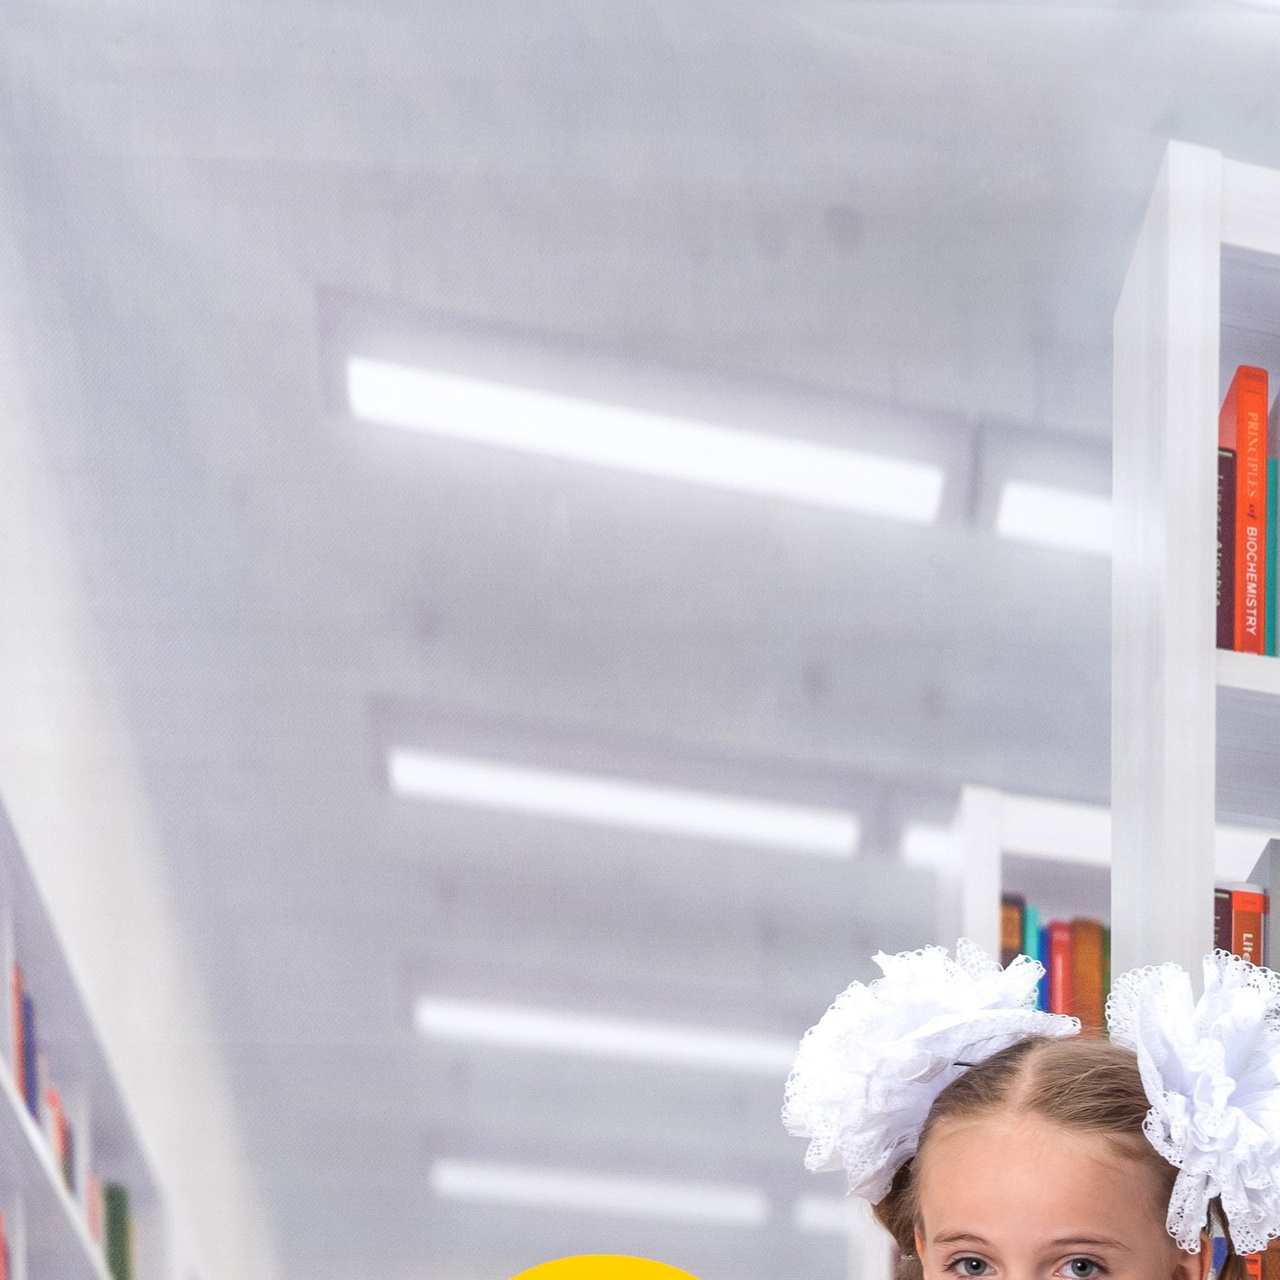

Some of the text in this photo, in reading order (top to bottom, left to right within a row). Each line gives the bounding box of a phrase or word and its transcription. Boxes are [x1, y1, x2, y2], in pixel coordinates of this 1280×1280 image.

[1245, 412, 1259, 635] PRINCIPLES of BIOCHEMISTRY
